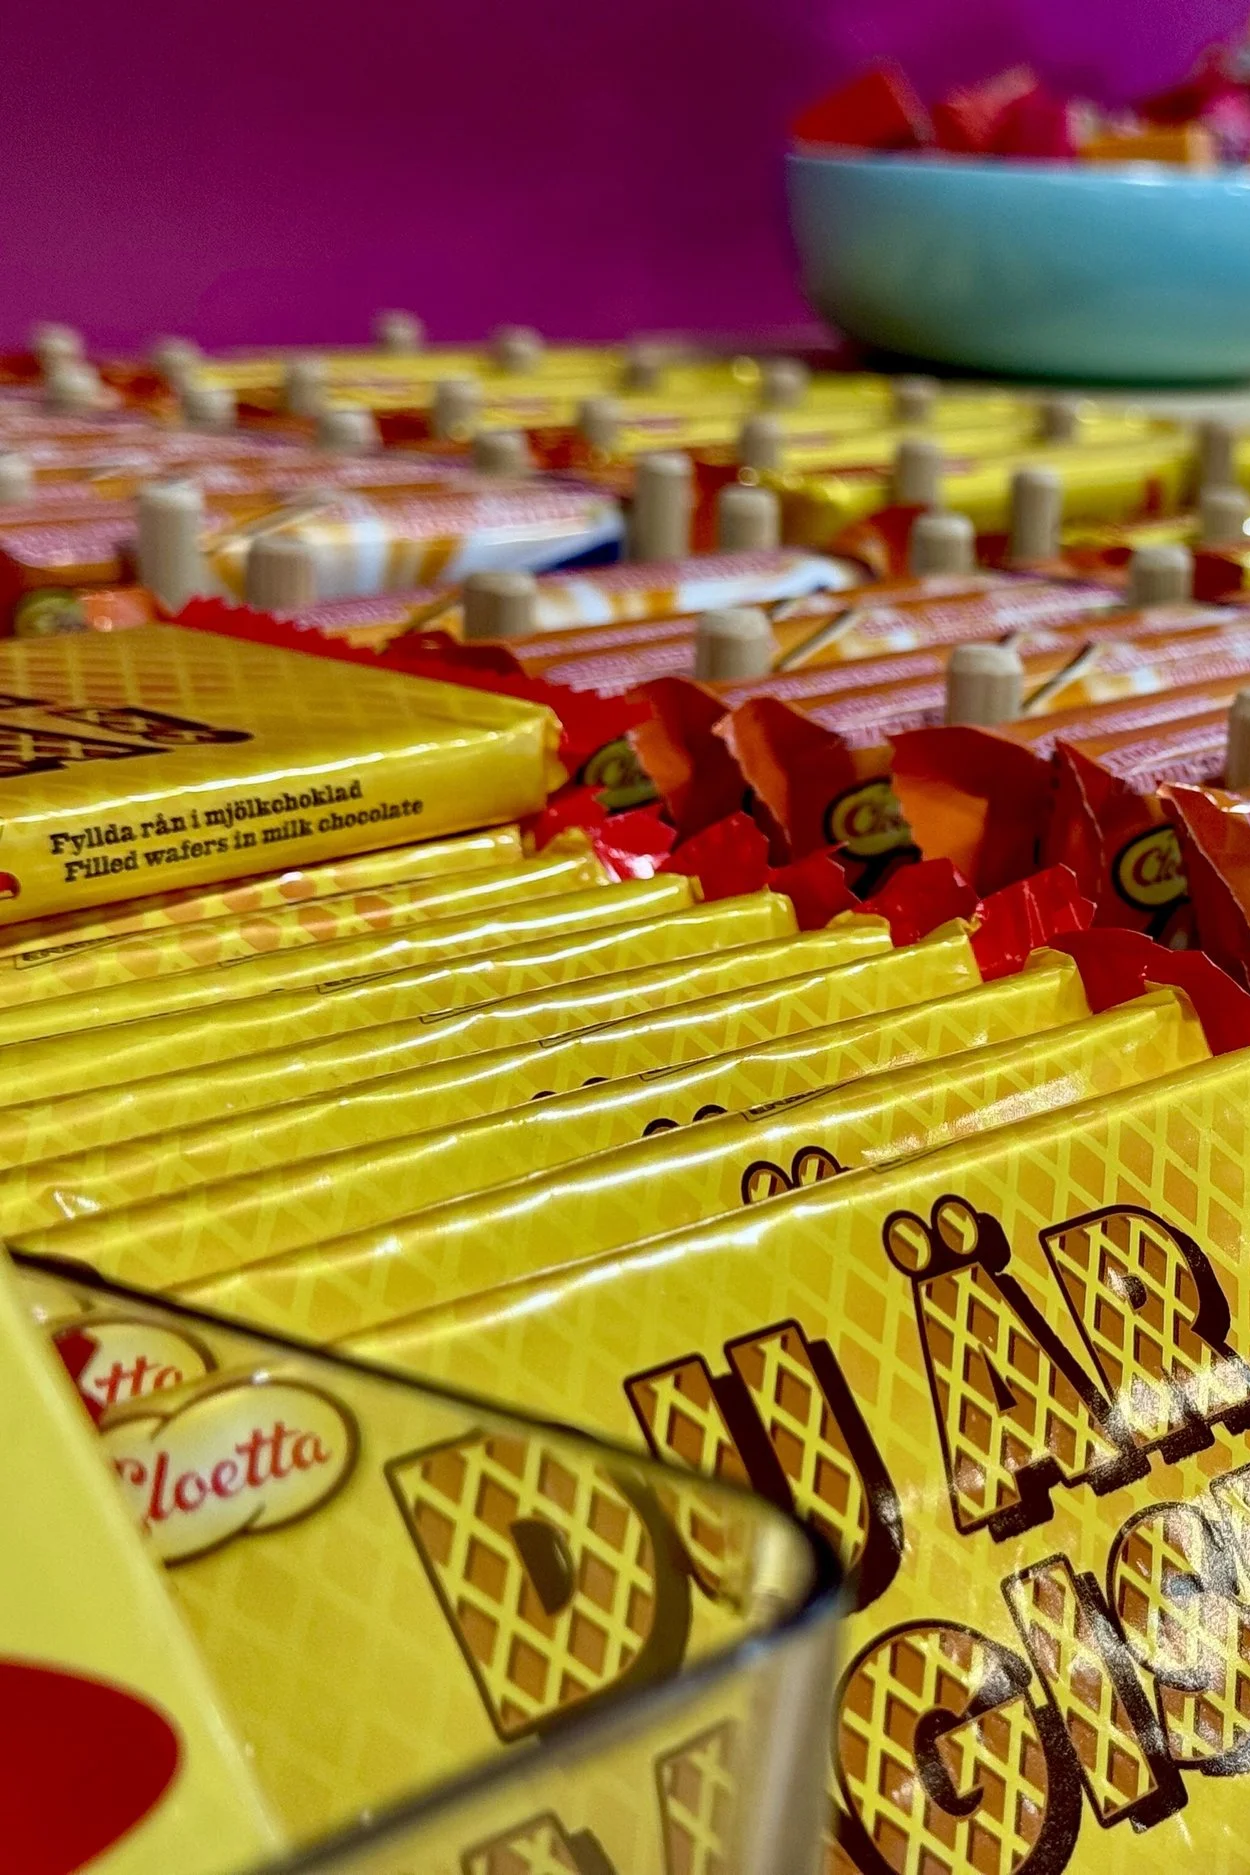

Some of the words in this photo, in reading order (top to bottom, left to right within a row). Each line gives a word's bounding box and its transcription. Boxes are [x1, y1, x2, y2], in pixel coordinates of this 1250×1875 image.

[49, 824, 137, 857] Fyllda
[140, 811, 187, 838] rån
[190, 808, 200, 832] i
[203, 779, 363, 830] mjölkchoklad
[64, 851, 139, 883] Filled
[144, 834, 229, 868] wafers
[233, 826, 259, 851] in
[262, 816, 313, 845] milk
[316, 797, 424, 833] chocolate
[384, 1317, 906, 1744] DU
